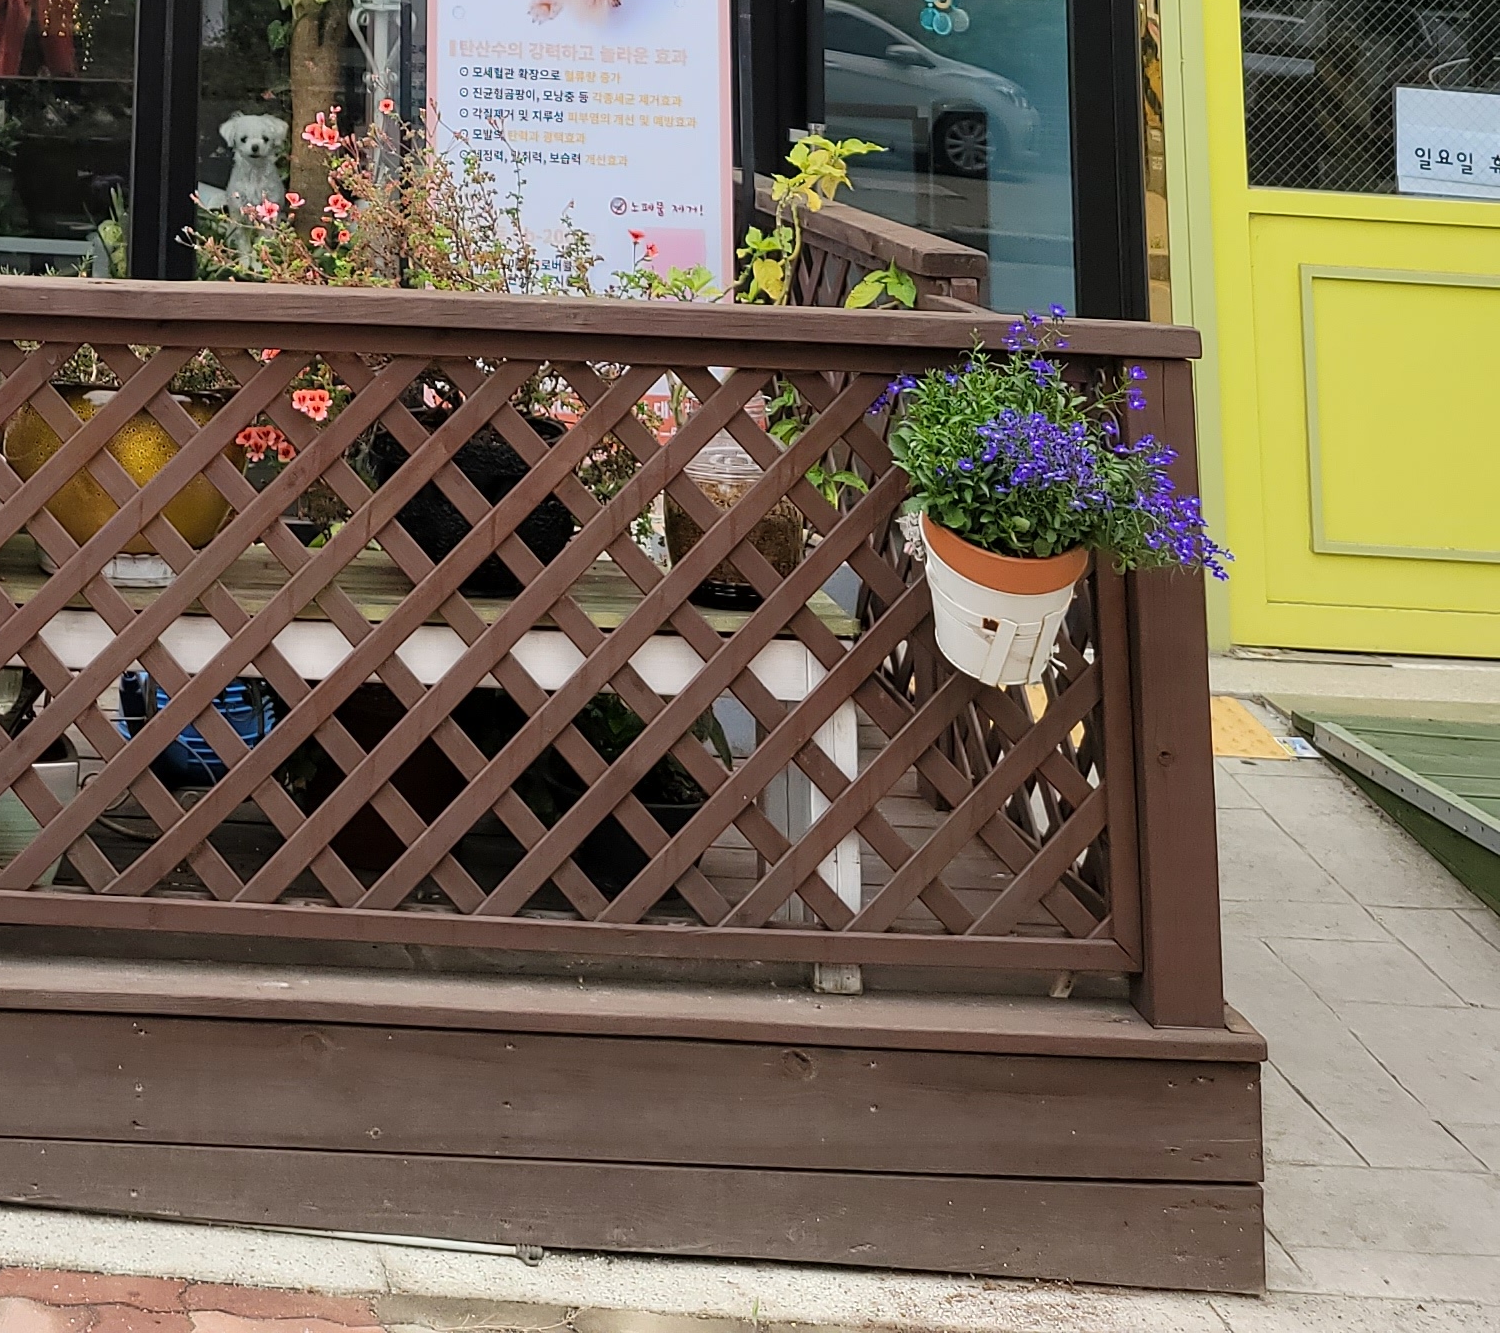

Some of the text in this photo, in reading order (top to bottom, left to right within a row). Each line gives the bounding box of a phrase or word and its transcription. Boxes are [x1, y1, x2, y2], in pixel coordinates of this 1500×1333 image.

[528, 42, 594, 62] 강력하고
[654, 47, 689, 67] 효과
[518, 68, 562, 81] 확장으로
[1414, 147, 1474, 175] 일요일
